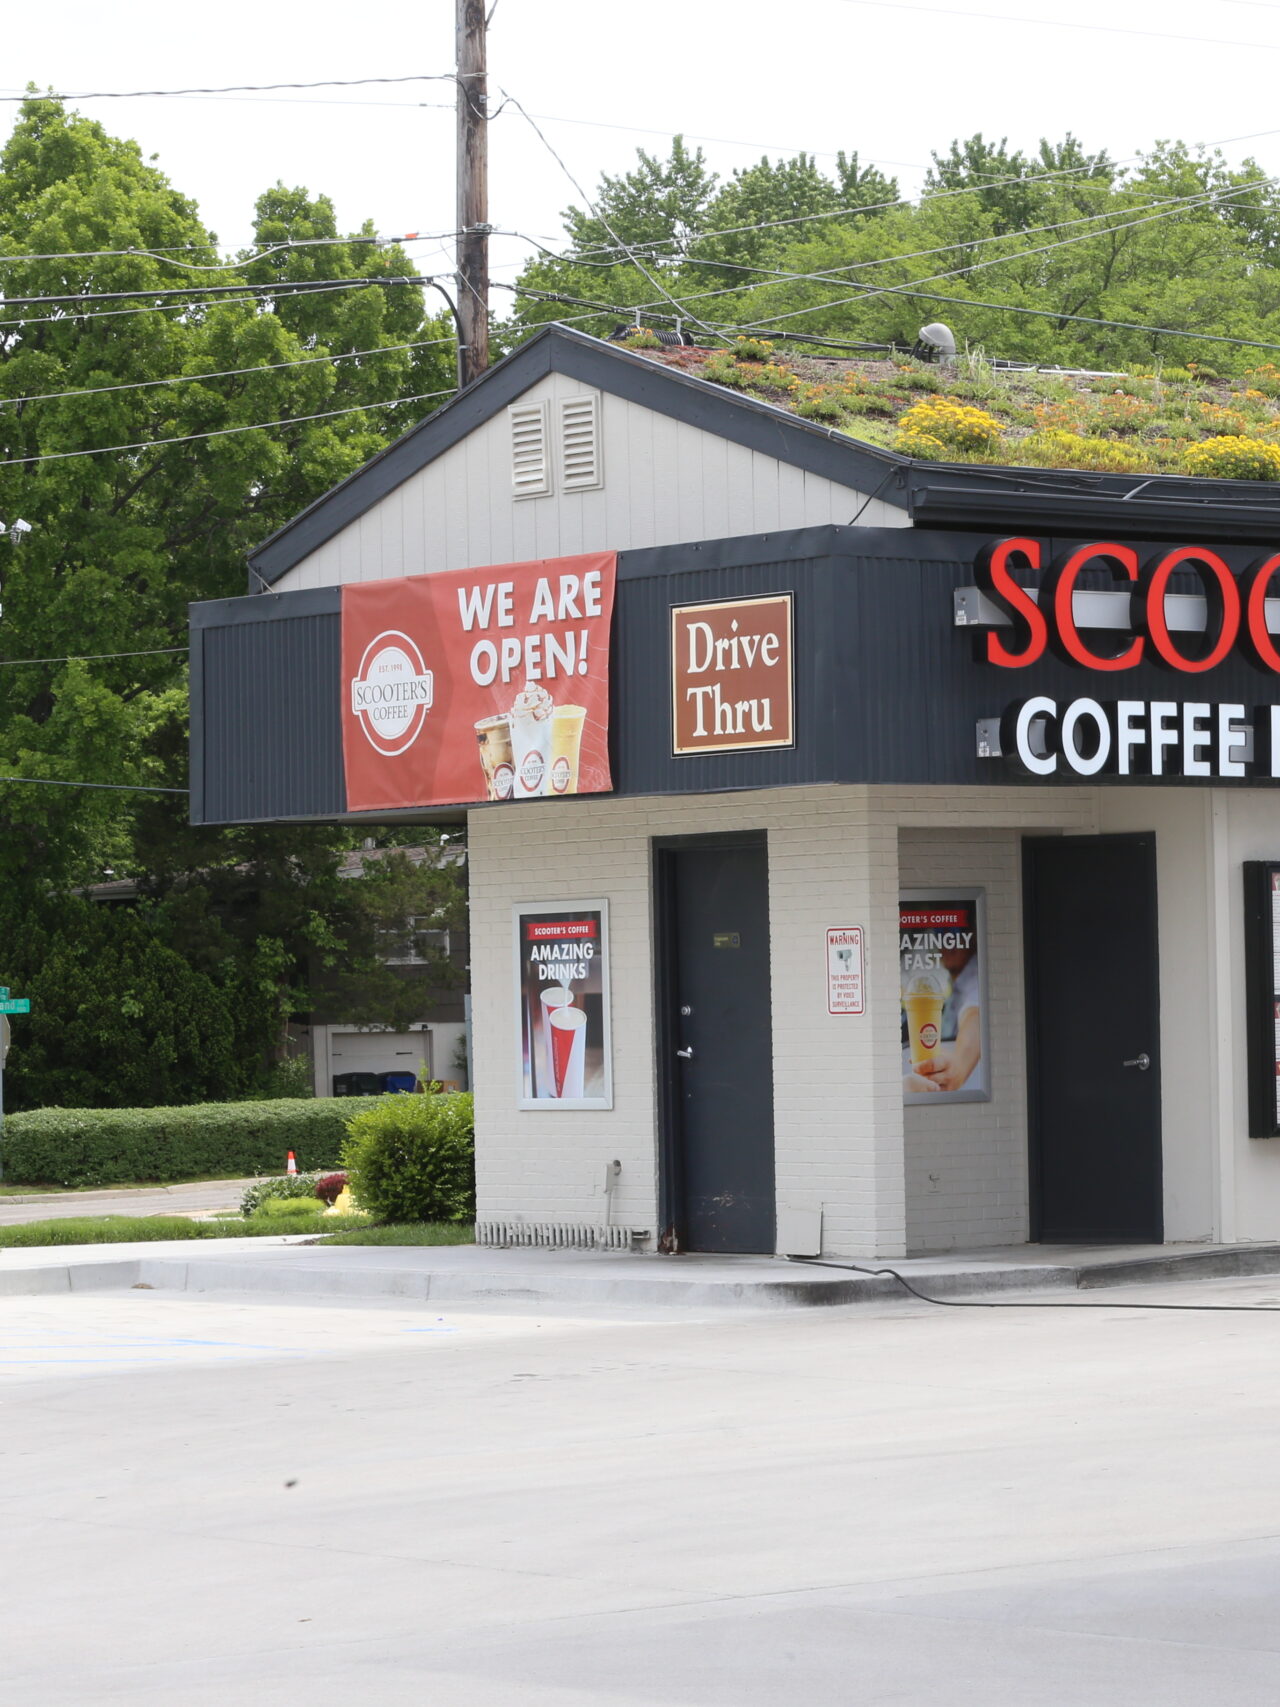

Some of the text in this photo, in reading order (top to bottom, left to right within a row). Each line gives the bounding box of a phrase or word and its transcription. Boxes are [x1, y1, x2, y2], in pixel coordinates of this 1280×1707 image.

[457, 570, 602, 631] WE ARE
[686, 619, 779, 674] Drive
[470, 630, 588, 687] OPEN!
[356, 680, 428, 706] SCOOTER'S
[373, 705, 409, 721] COFFEE
[686, 682, 773, 737] Thru
[1016, 696, 1247, 776] COFFEE
[901, 915, 958, 924] OTER'S COFFEE
[534, 925, 589, 936] SCOOTER'S COFFEE
[829, 934, 860, 946] WARNING
[900, 932, 973, 950] AZINGLY
[530, 942, 594, 961] AMAZING
[904, 952, 943, 970] FAST
[538, 962, 587, 980] DRINKS
[0, 999, 15, 1011] and
